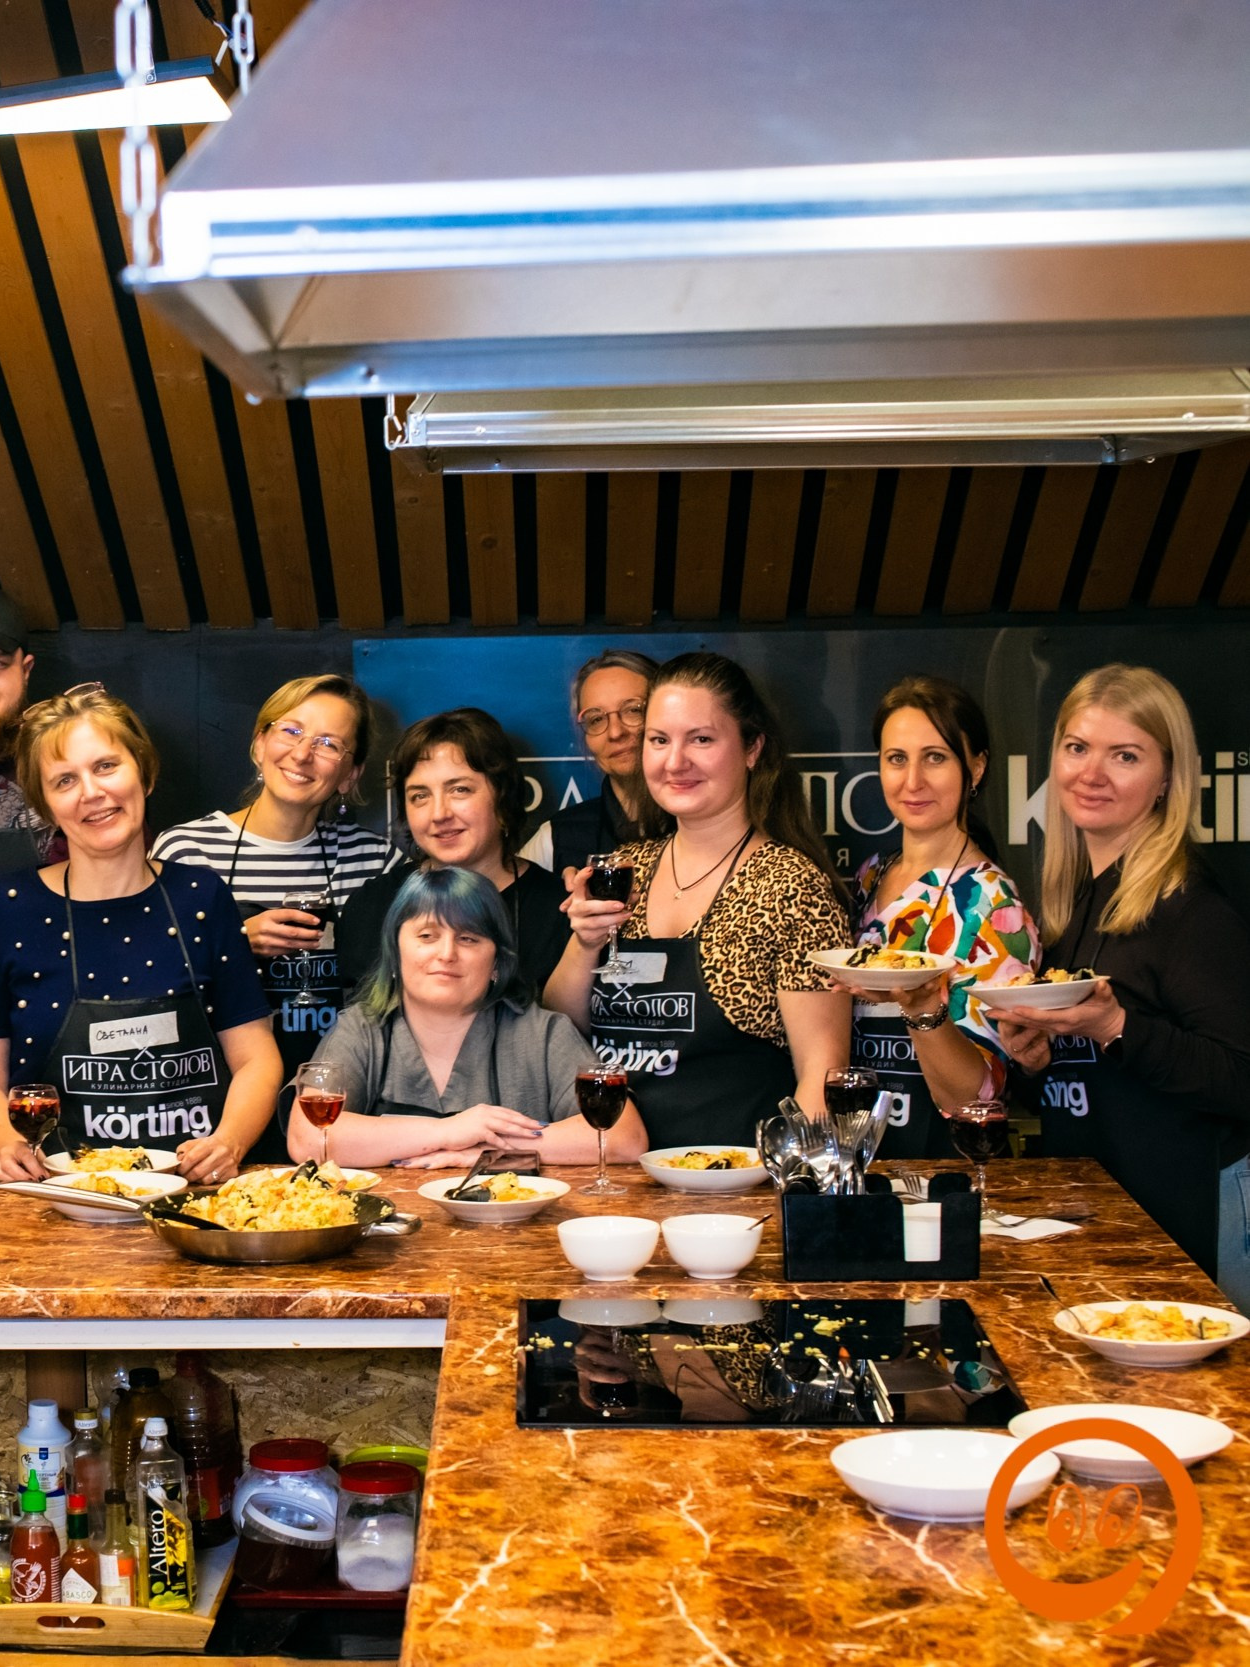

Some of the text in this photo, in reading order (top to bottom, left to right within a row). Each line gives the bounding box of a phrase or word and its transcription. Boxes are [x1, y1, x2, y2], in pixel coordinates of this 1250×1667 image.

[282, 1000, 337, 1037] ting
[610, 998, 688, 1018] СТОЛОВ
[68, 1053, 211, 1082] ИГРА СТОЛОВ
[91, 1077, 190, 1091] КУЛИНАРНАЯ СТУДИЯ
[83, 1103, 213, 1140] körting
[149, 1508, 169, 1576] Altero
[62, 1590, 92, 1600] ABASCO
